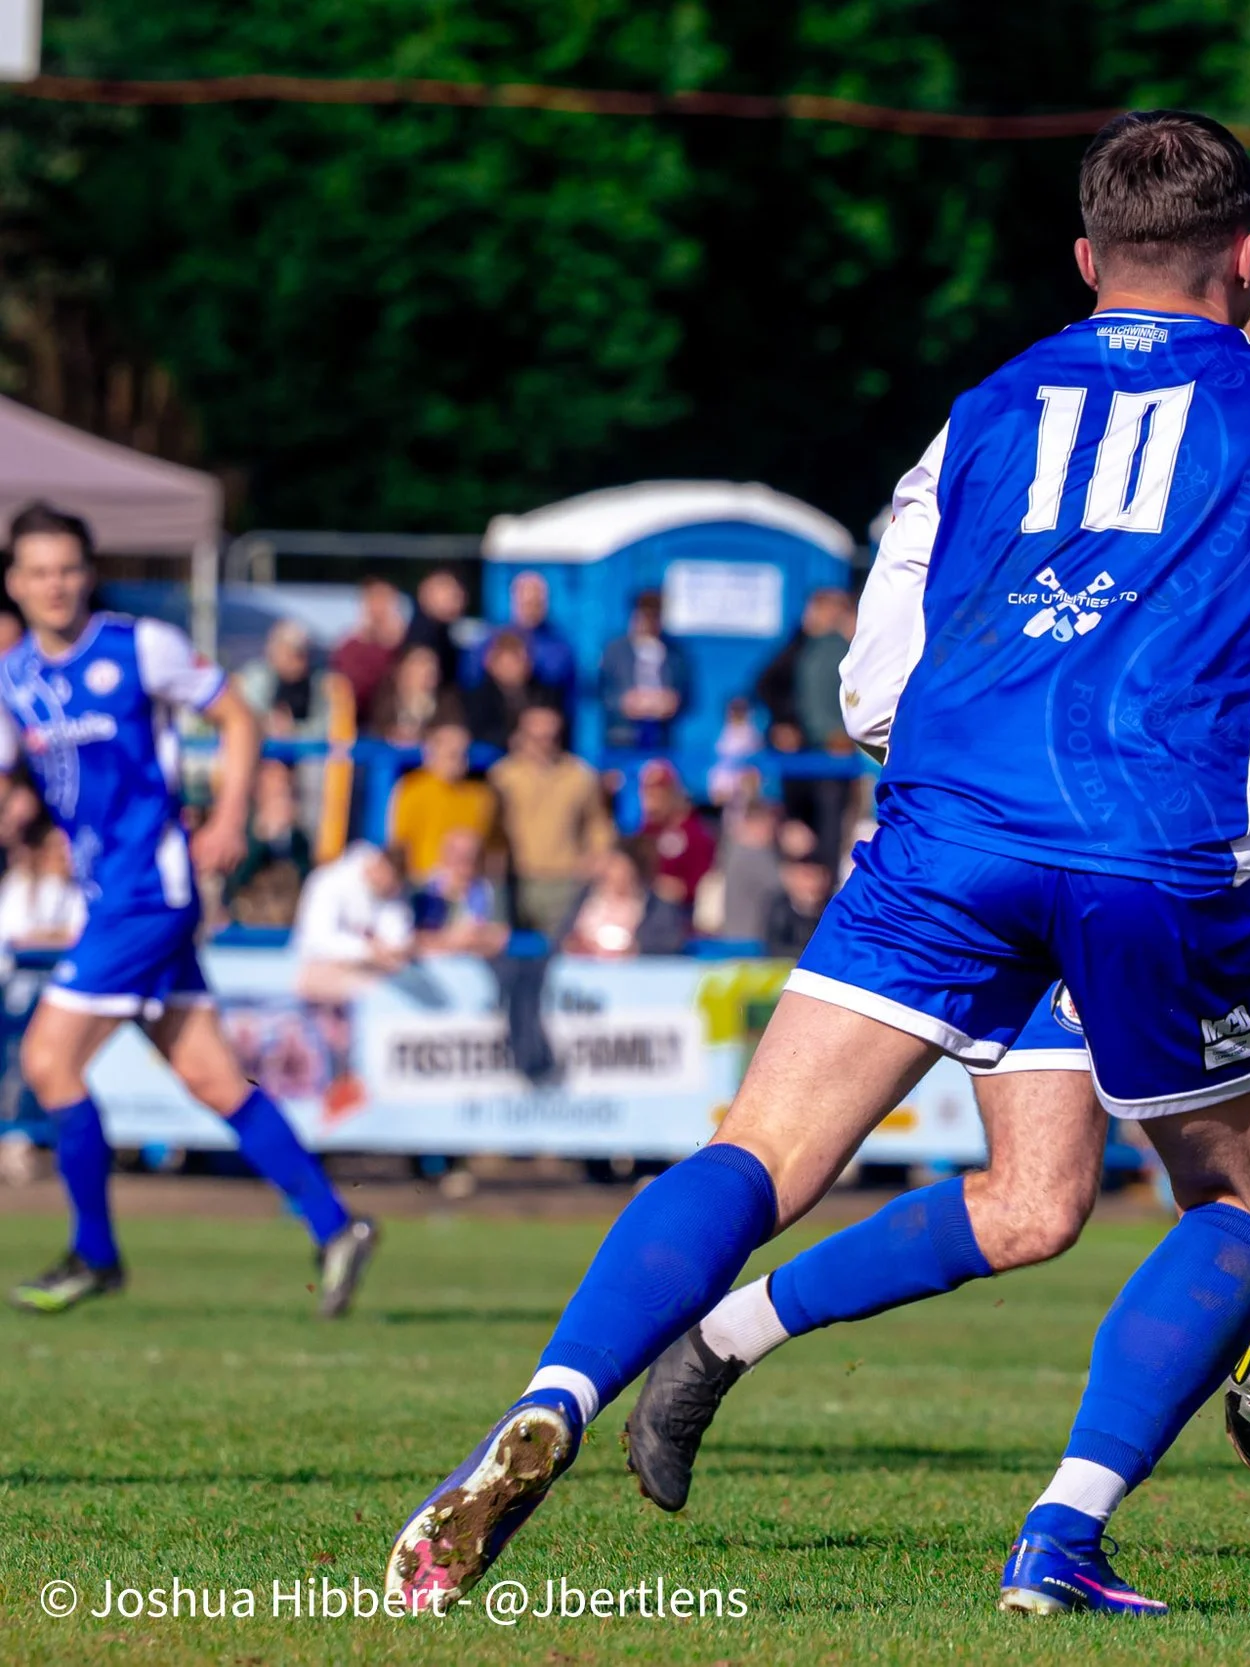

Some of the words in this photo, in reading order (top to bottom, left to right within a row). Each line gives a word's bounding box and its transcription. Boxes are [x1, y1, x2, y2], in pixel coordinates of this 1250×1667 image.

[1099, 324, 1166, 342] MATCHWINNER
[1021, 380, 1196, 534] 10
[1008, 593, 1038, 605] CKR
[1041, 592, 1110, 608] UTILITIES
